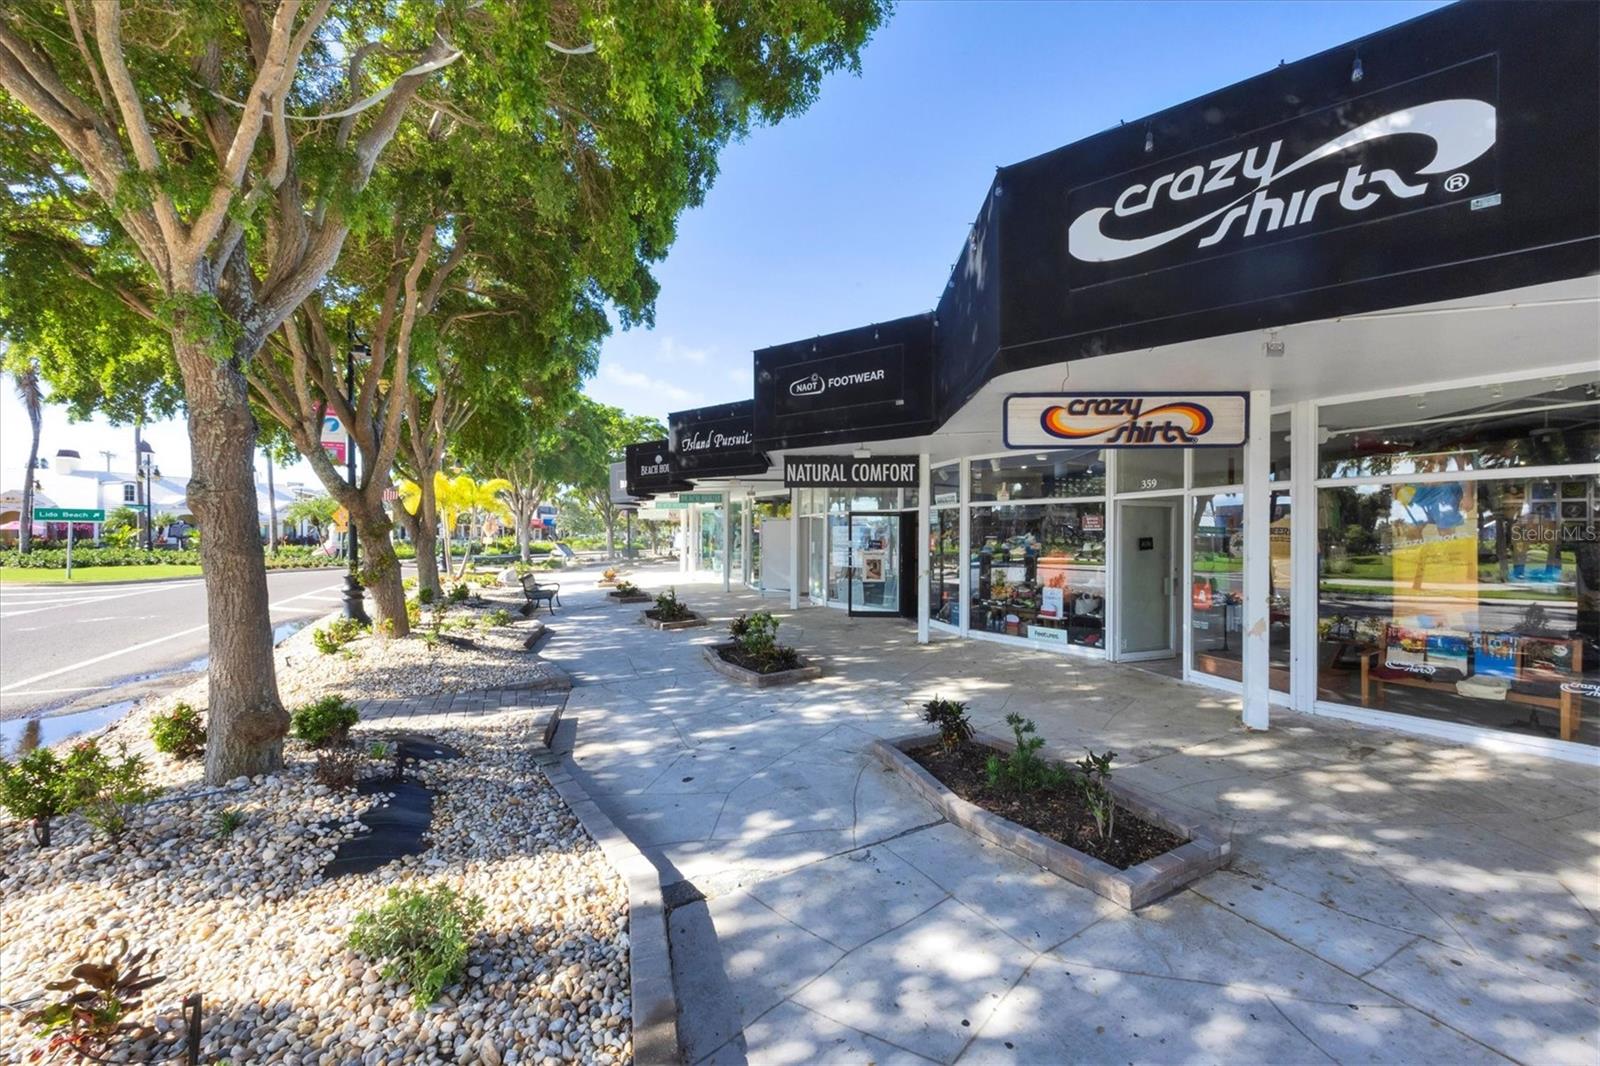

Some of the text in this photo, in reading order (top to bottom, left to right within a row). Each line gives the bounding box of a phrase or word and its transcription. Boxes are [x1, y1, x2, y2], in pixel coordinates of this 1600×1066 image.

[1114, 139, 1283, 217] crazy
[1198, 164, 1429, 248] shirts
[796, 369, 885, 393] NAOT FOOTWEAR
[1067, 398, 1143, 420] crazy
[682, 430, 753, 452] Island Pursuit
[1106, 421, 1195, 444] shirts
[640, 464, 658, 476] BEACH
[787, 463, 916, 482] NATURAL COMFORT
[1141, 479, 1158, 489] 359
